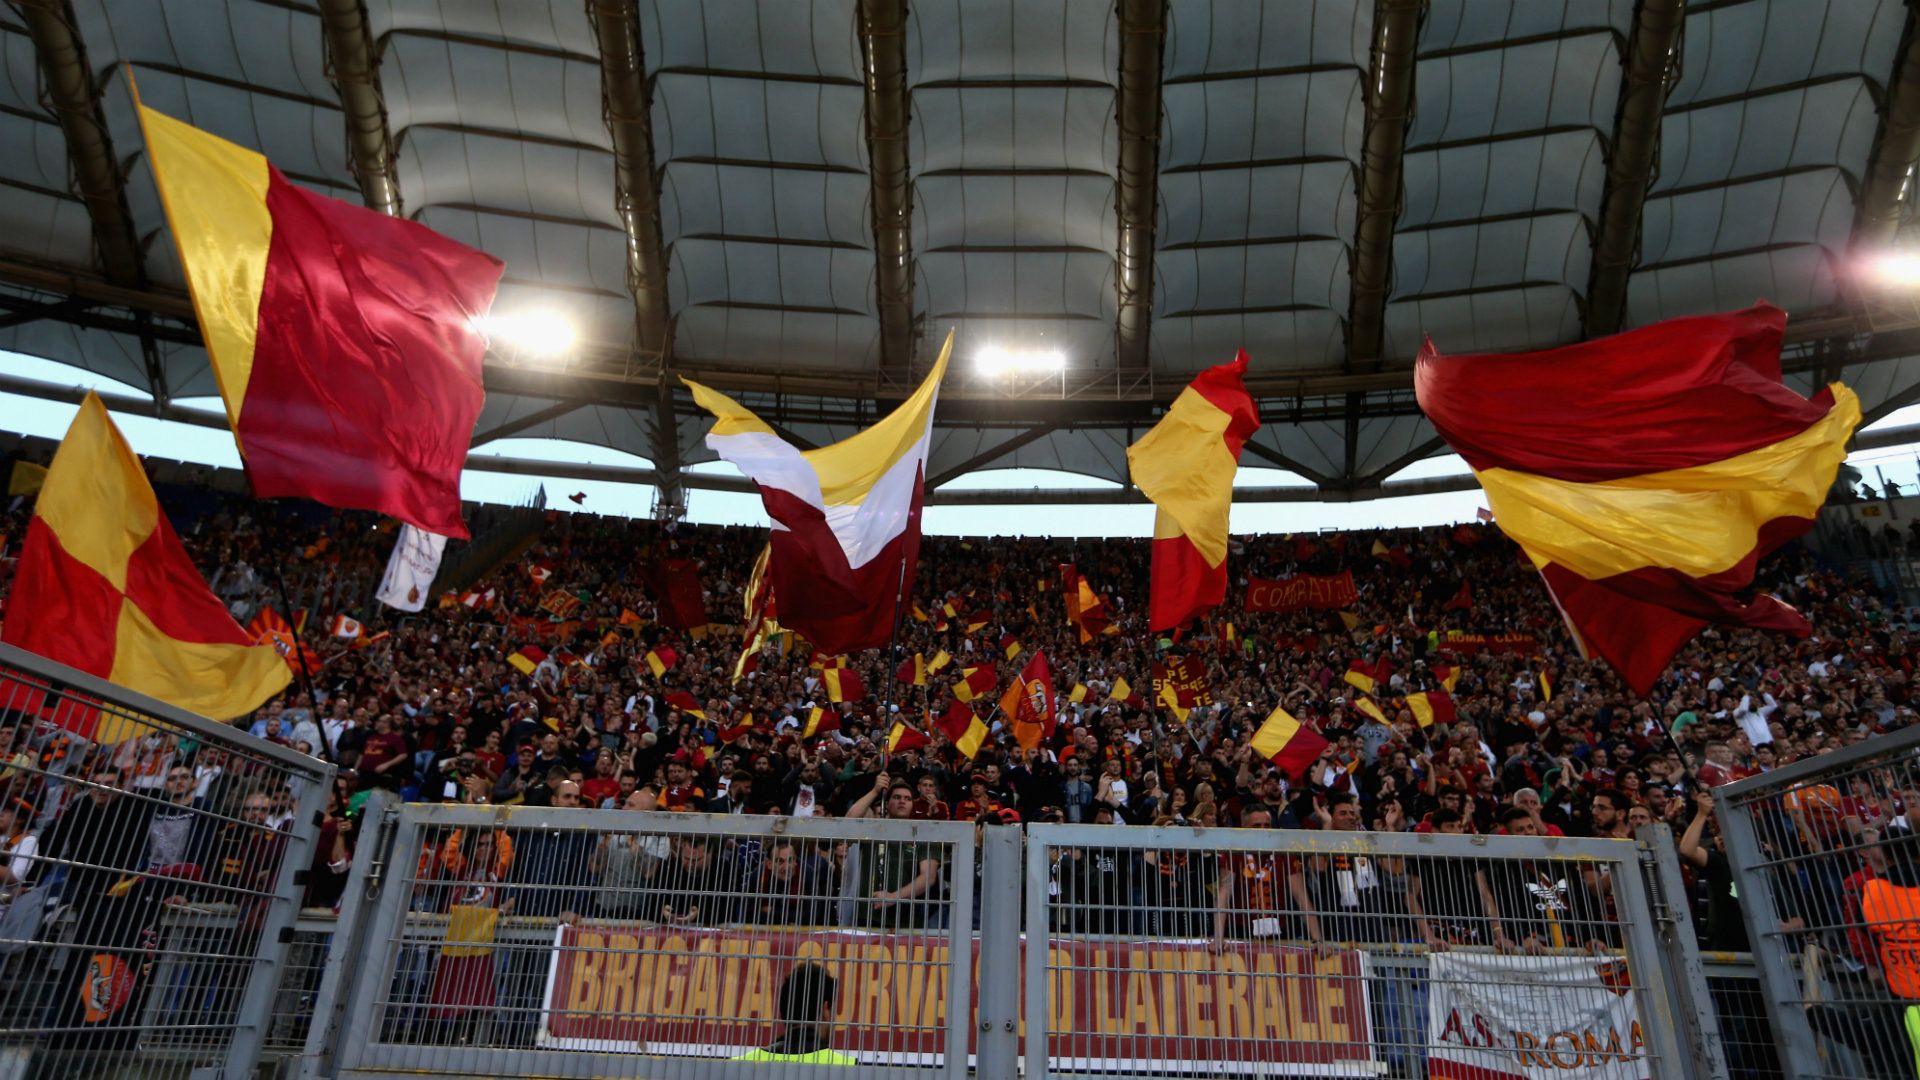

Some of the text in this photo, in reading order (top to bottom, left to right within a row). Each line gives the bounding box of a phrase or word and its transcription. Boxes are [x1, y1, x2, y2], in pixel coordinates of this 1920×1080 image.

[1447, 633, 1485, 644] ROMA
[565, 932, 774, 1028] BRIGATA
[796, 940, 948, 1033] URVA
[1094, 949, 1350, 1043] LATERALE
[1510, 1018, 1645, 1070] ROMA
